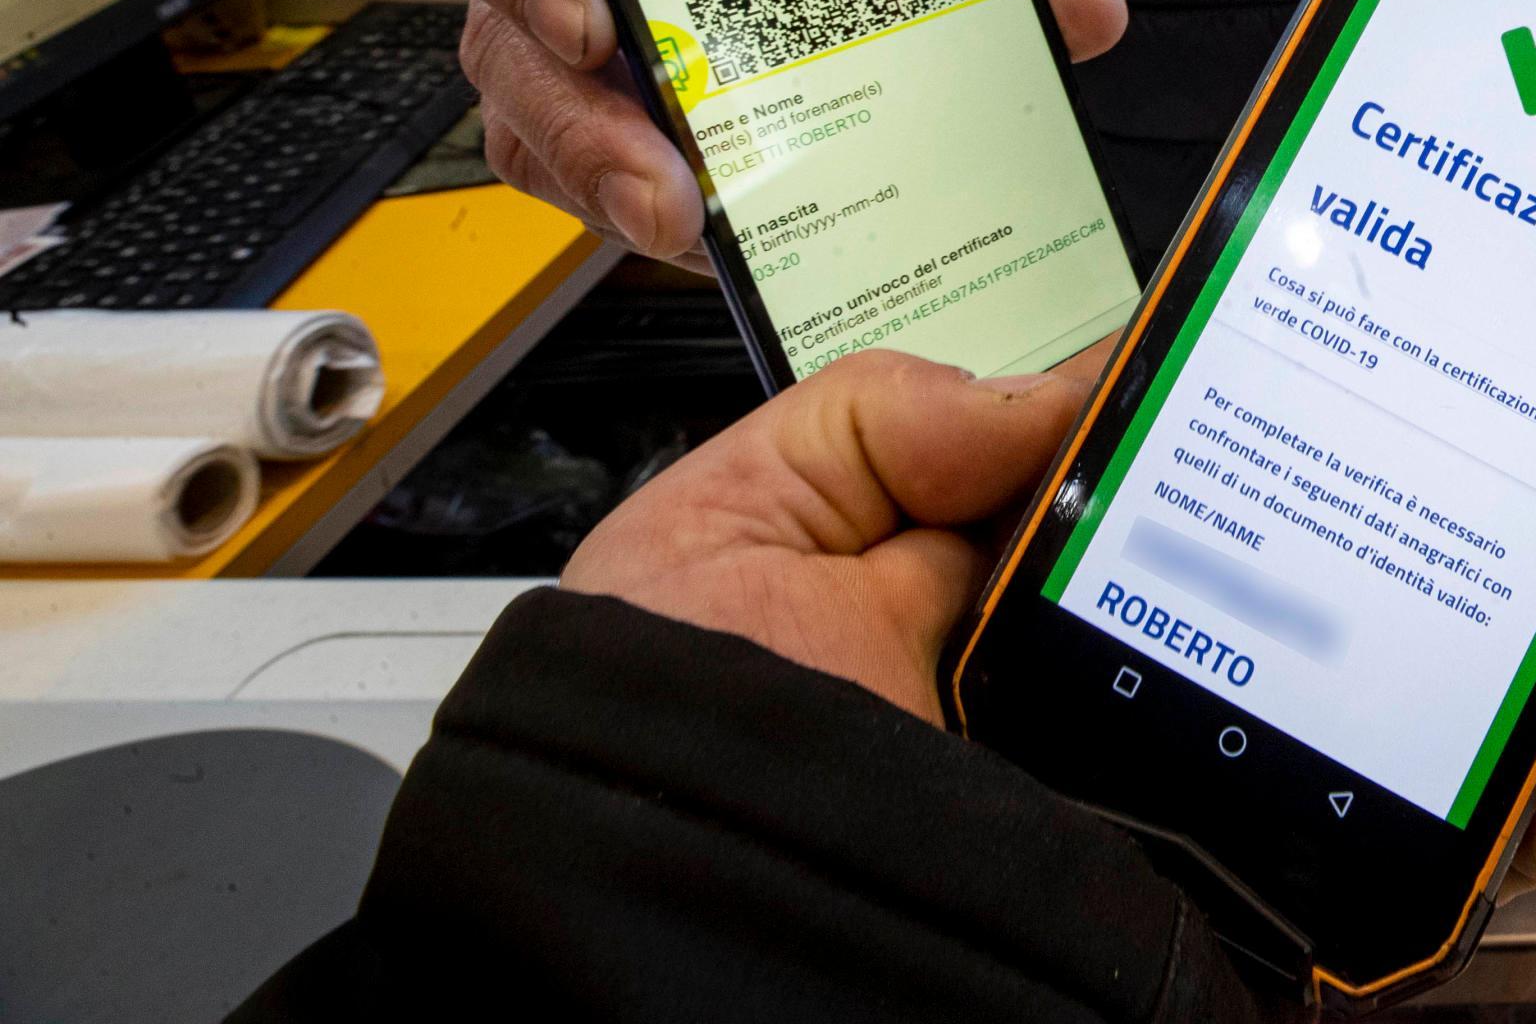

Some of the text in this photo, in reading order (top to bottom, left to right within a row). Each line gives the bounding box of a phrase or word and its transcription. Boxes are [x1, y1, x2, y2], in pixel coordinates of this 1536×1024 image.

[702, 81, 882, 160] me(s) and forename(s)
[737, 113, 750, 125] e
[752, 93, 804, 119] Nome
[786, 109, 872, 152] ROBERTO
[736, 202, 819, 244] di nascita
[741, 243, 757, 262] of
[1309, 184, 1432, 271] valida
[778, 225, 1013, 342] ficativo univoco del certificato
[800, 306, 879, 349] Certificate
[879, 274, 942, 311] identifier
[1268, 266, 1306, 297] Cosa
[1307, 291, 1324, 306] si
[1322, 299, 1356, 322] può
[1357, 313, 1390, 341] fare
[1392, 335, 1421, 358] con
[1423, 348, 1439, 368] la
[1253, 296, 1378, 369] verde COVID-19
[1188, 418, 1512, 600] confrontare i seguenti dati anagrafici con
[1203, 386, 1505, 559] Per completare la verifica è necessario
[1153, 480, 1265, 551] NOME/NAME
[1173, 447, 1491, 627] quelli di un documento d'identità valido:
[1096, 580, 1254, 687] ROBERTO
